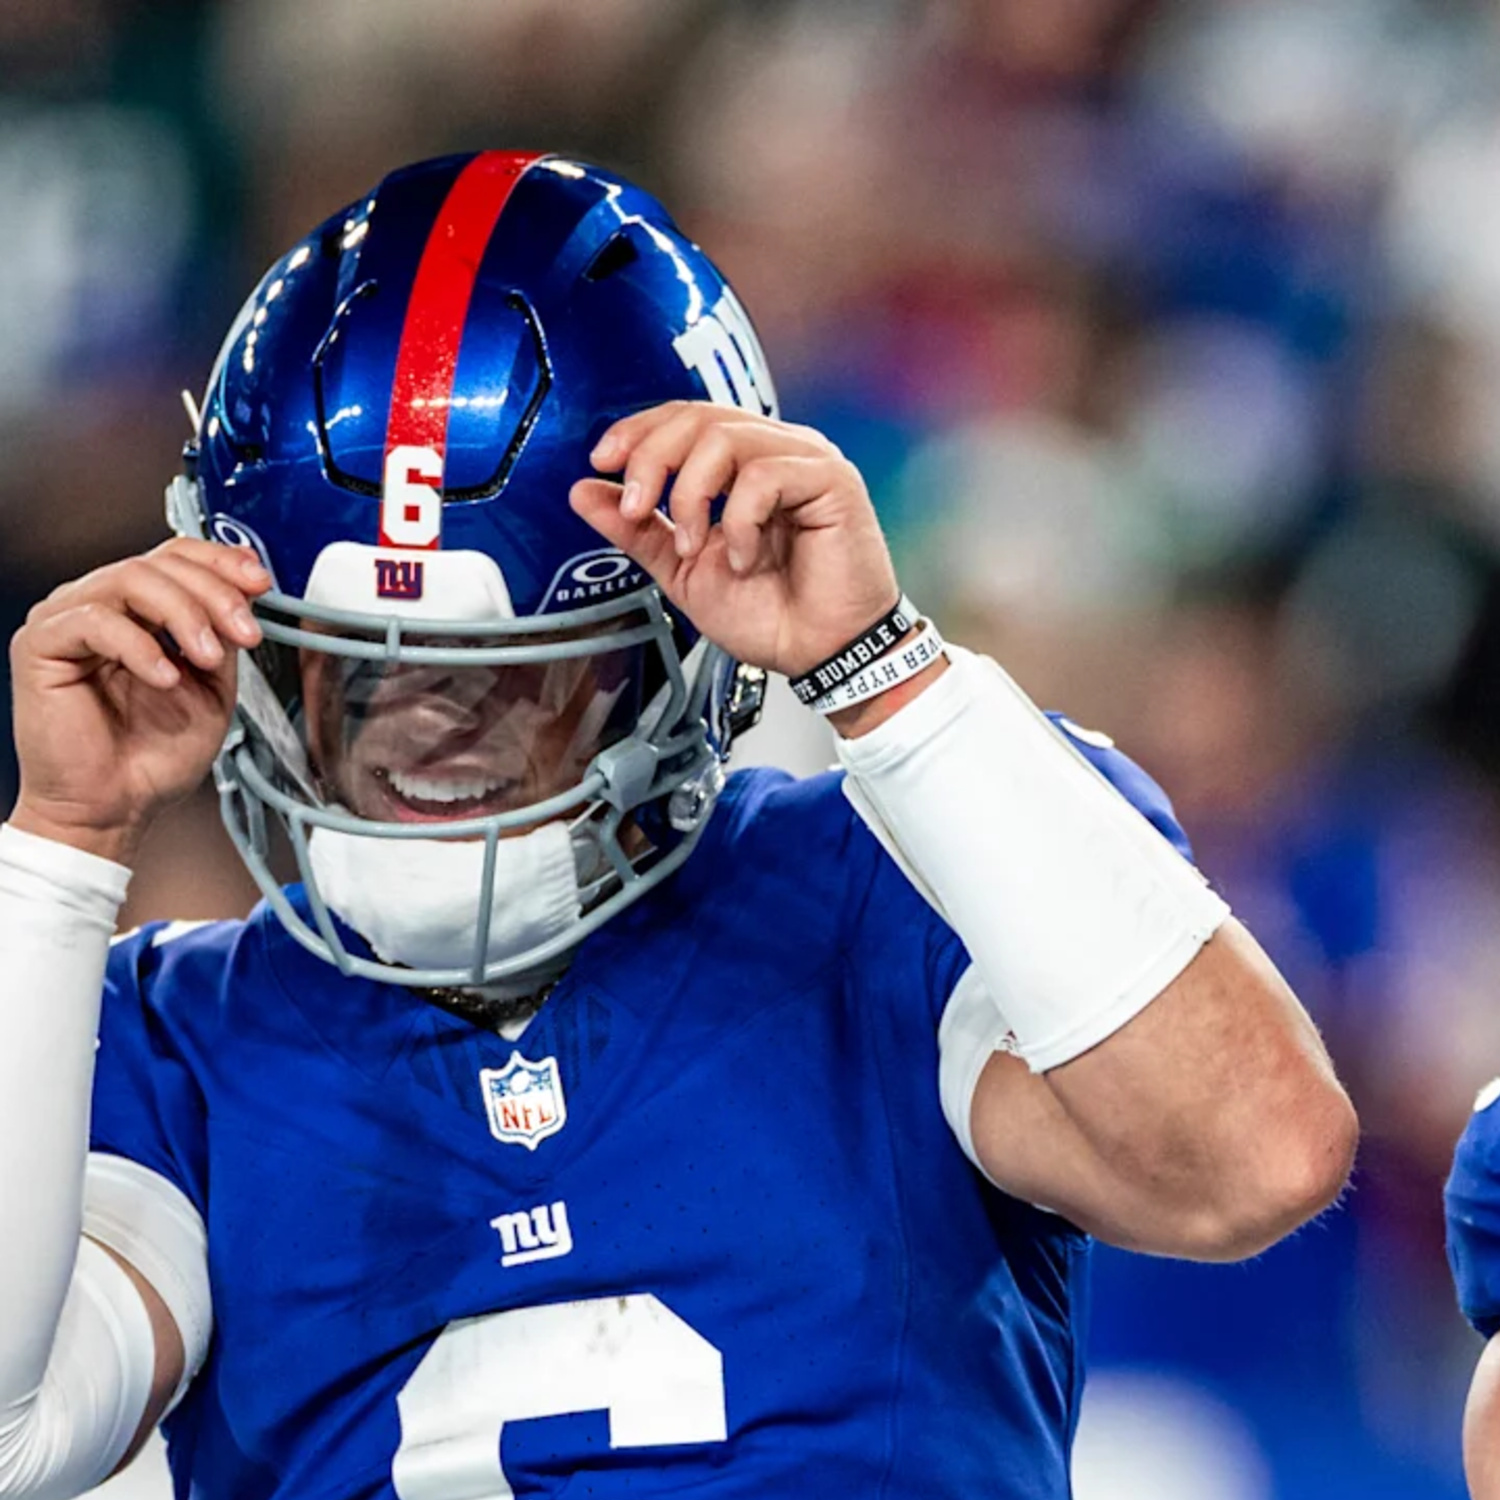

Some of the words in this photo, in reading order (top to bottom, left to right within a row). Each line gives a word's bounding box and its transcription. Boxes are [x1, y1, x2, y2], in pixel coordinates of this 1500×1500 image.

[383, 445, 443, 546] 6
[556, 572, 642, 602] OAKLEY
[815, 625, 896, 689] HUMBLE
[903, 635, 943, 670] VER
[846, 662, 899, 699] HYPE
[499, 1100, 553, 1130] NFL
